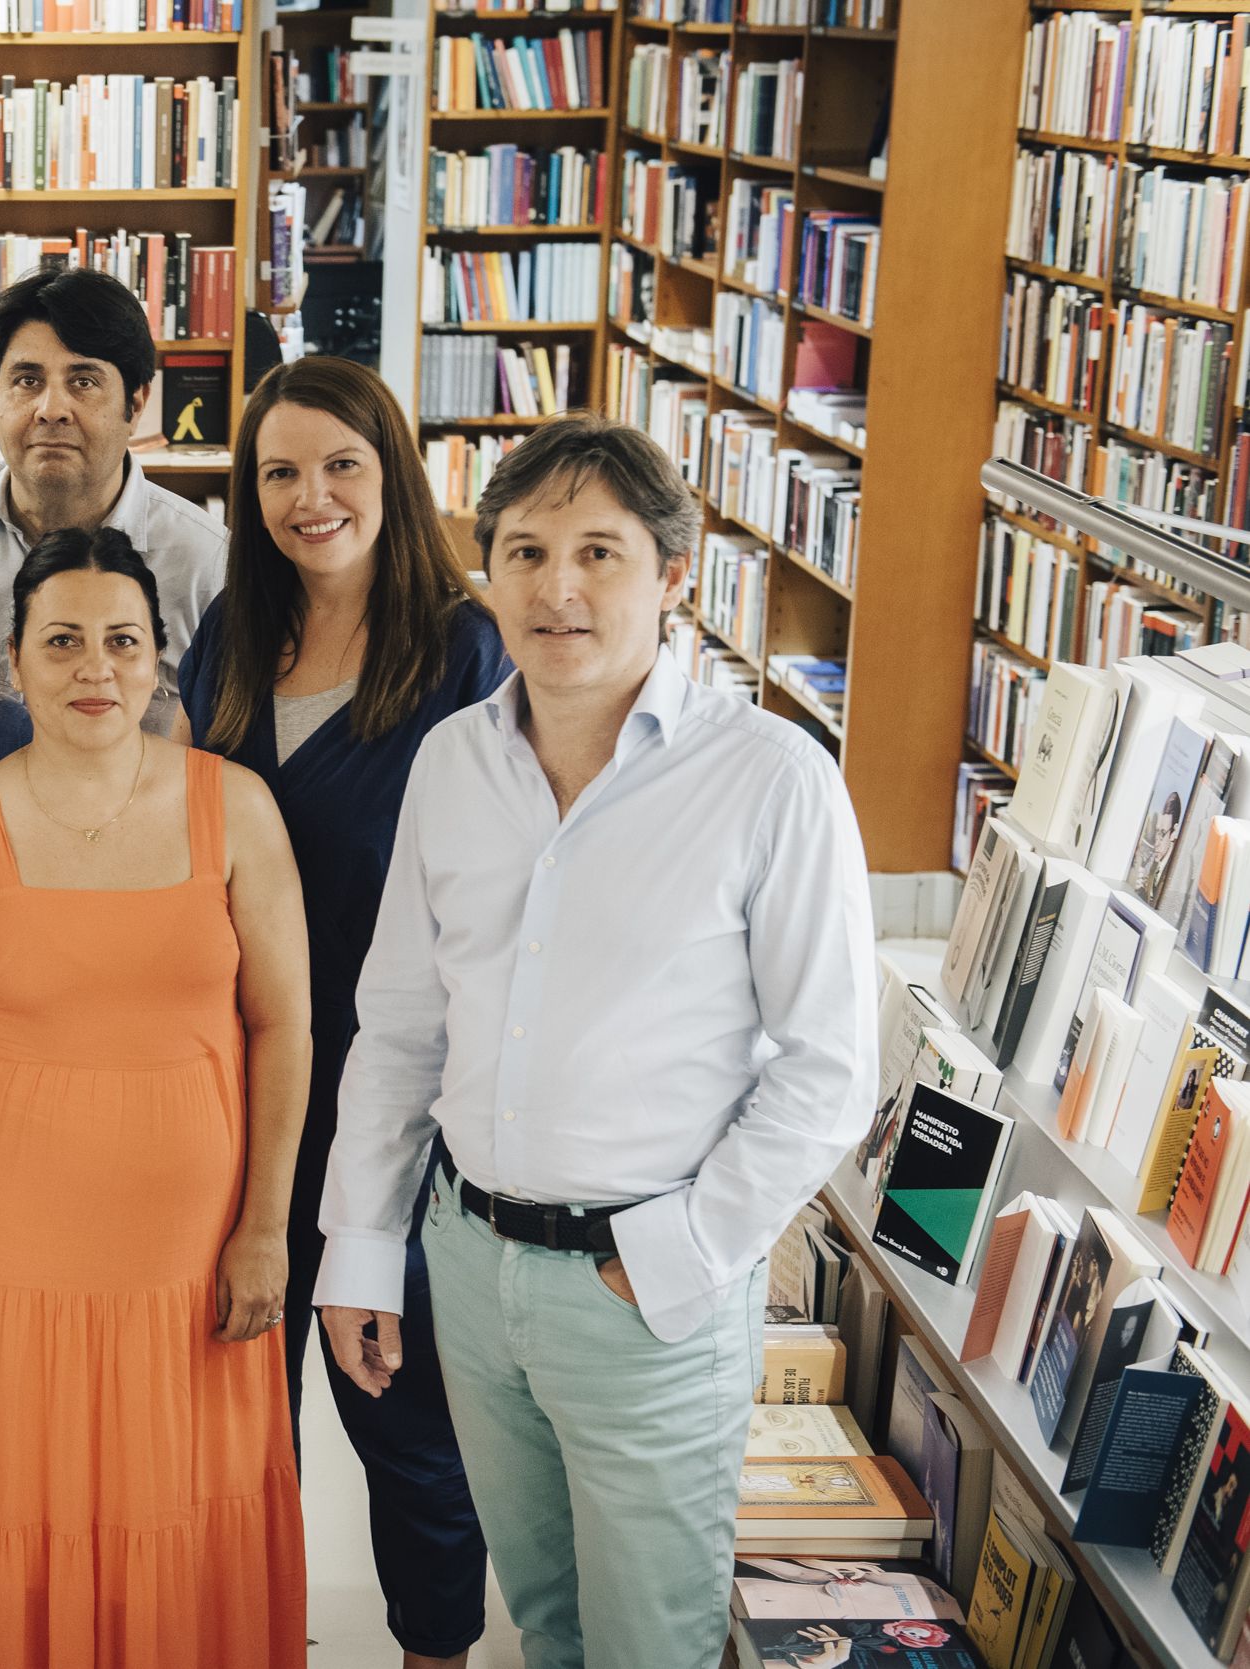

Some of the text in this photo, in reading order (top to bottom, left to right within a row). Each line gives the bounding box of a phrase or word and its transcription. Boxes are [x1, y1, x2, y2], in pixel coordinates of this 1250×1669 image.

[911, 1117, 964, 1150] POR UNA VIDA
[914, 1108, 960, 1137] MANIFIESTO
[908, 1126, 954, 1156] VERDADERA
[875, 1230, 889, 1244] Luis
[886, 1237, 902, 1251] Roca
[782, 1368, 797, 1405] DE LAS CIEN
[797, 1377, 812, 1405] FILOSOFÍ
[816, 1389, 825, 1405] MANU
[895, 1591, 915, 1617] EROTISMO
